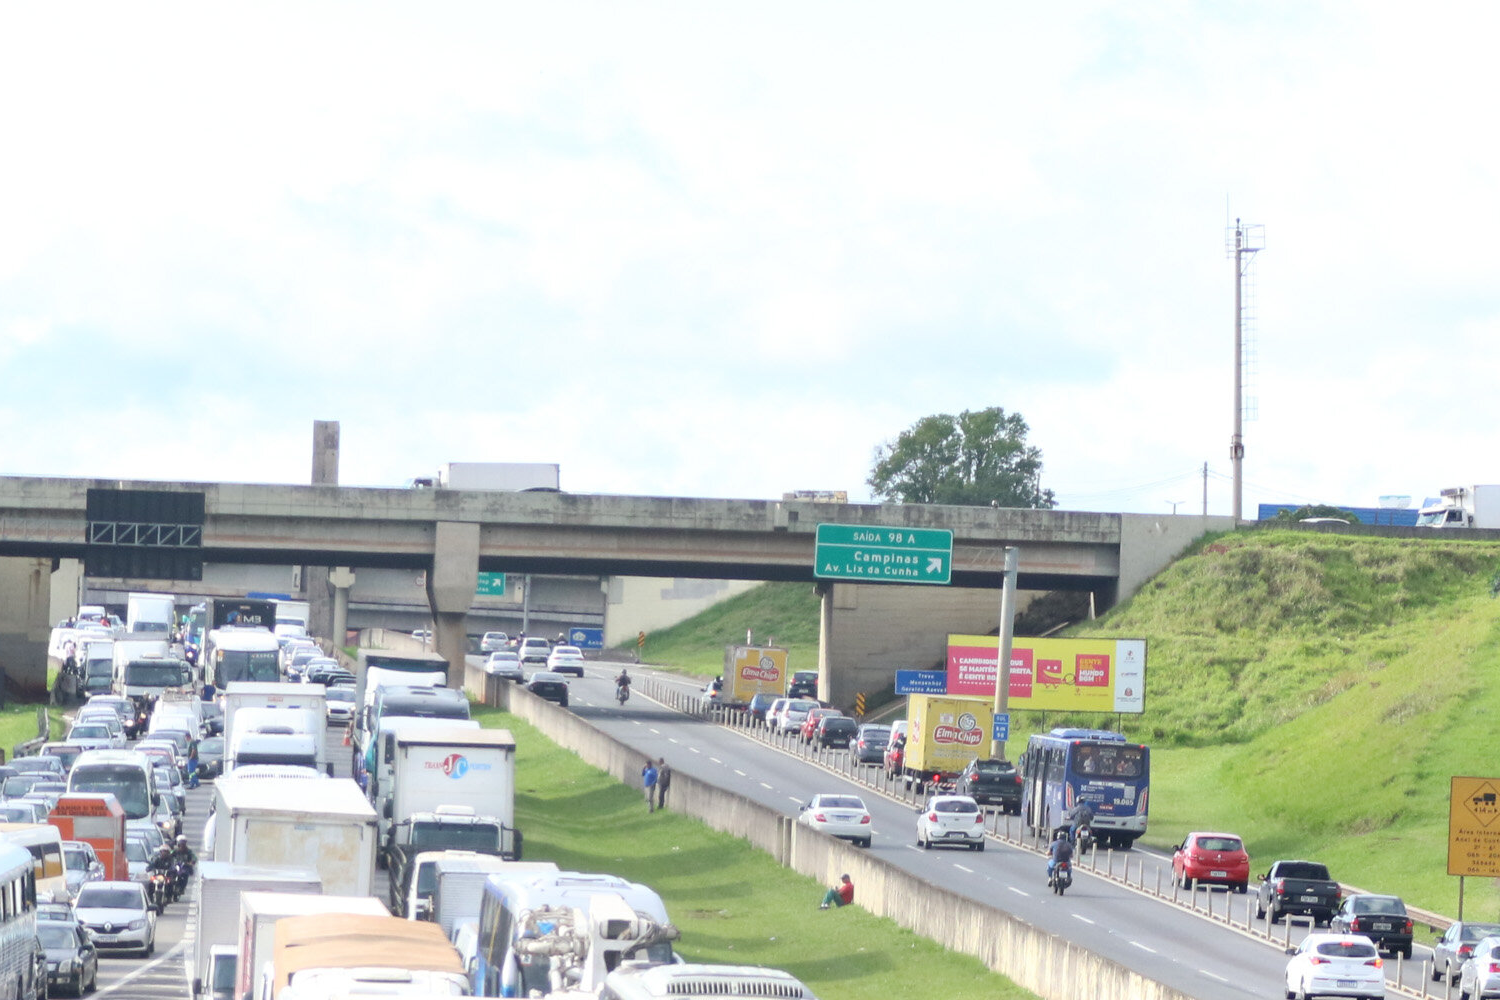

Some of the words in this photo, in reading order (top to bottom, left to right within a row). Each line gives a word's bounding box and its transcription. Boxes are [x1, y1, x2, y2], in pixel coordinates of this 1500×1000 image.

[853, 530, 881, 542] SAÍDA
[888, 532, 903, 544] 98
[907, 534, 916, 544] A
[854, 551, 919, 565] Campinas
[846, 564, 864, 574] Lix
[867, 566, 880, 574] da
[884, 566, 918, 577] Cunha
[936, 728, 957, 739] Elma
[959, 732, 981, 743] Chips
